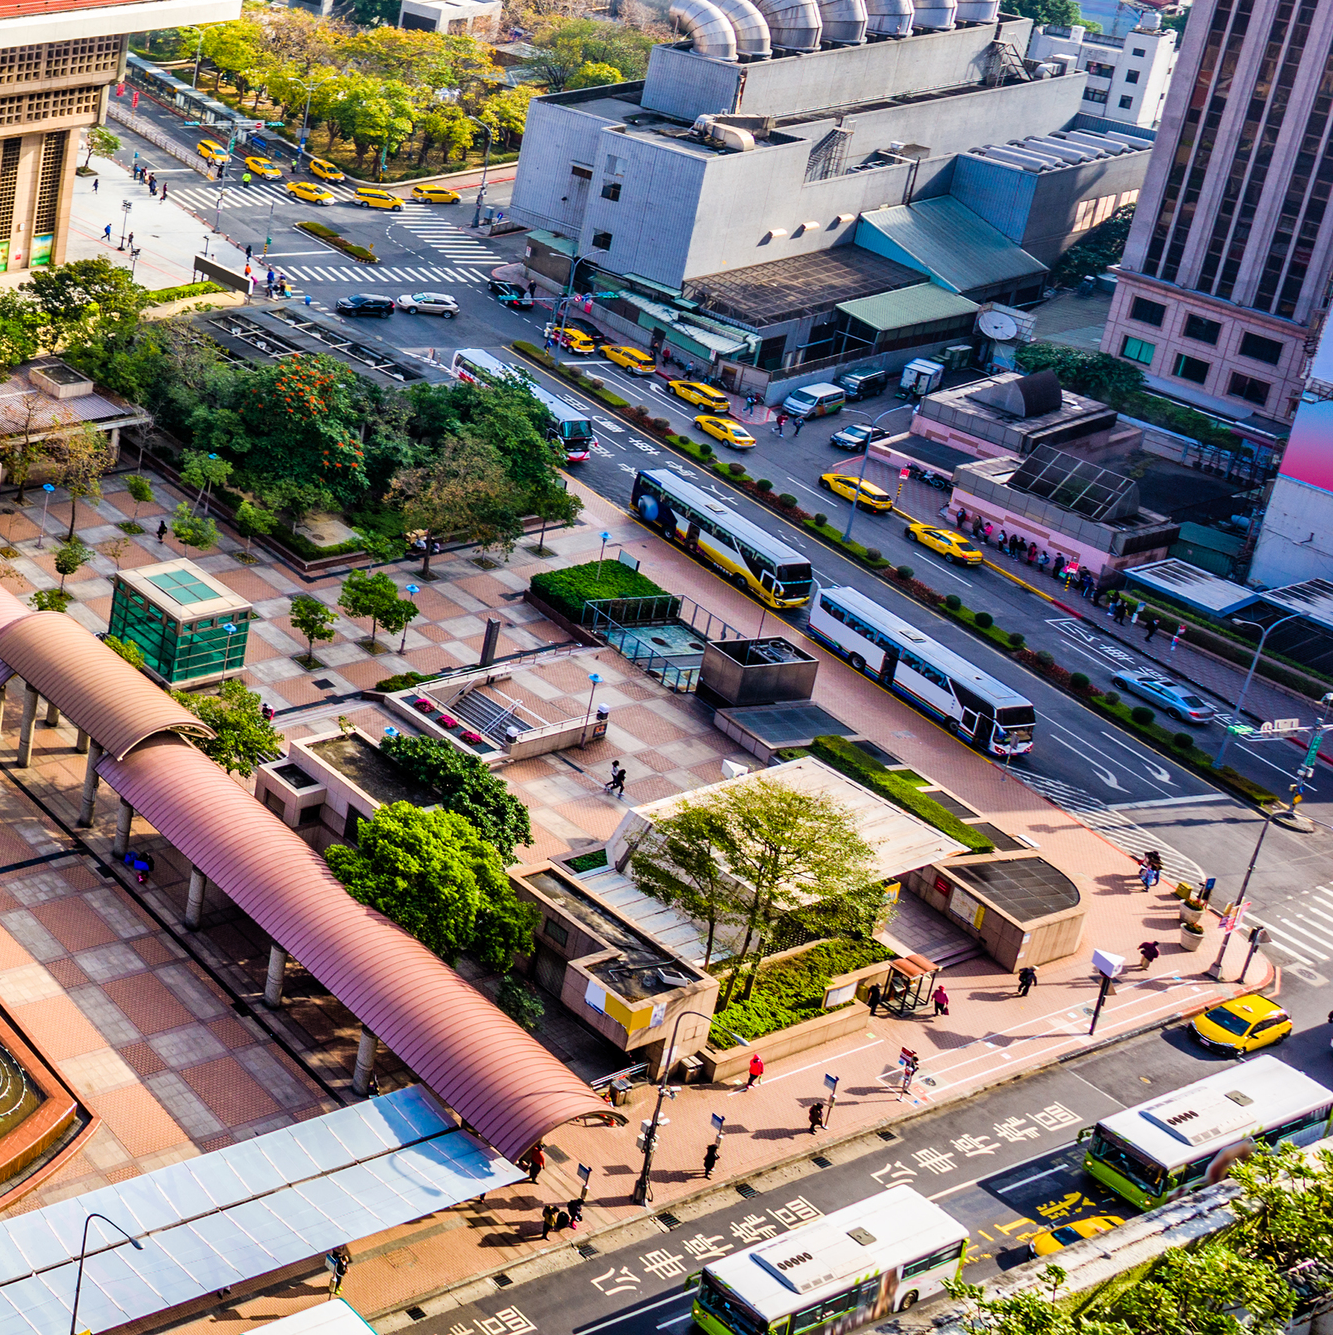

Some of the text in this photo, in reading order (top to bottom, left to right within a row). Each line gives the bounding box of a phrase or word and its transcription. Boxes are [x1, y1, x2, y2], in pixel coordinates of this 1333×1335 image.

[870, 1101, 1083, 1188] 公車停靠區
[590, 1195, 825, 1296] 公車停靠區
